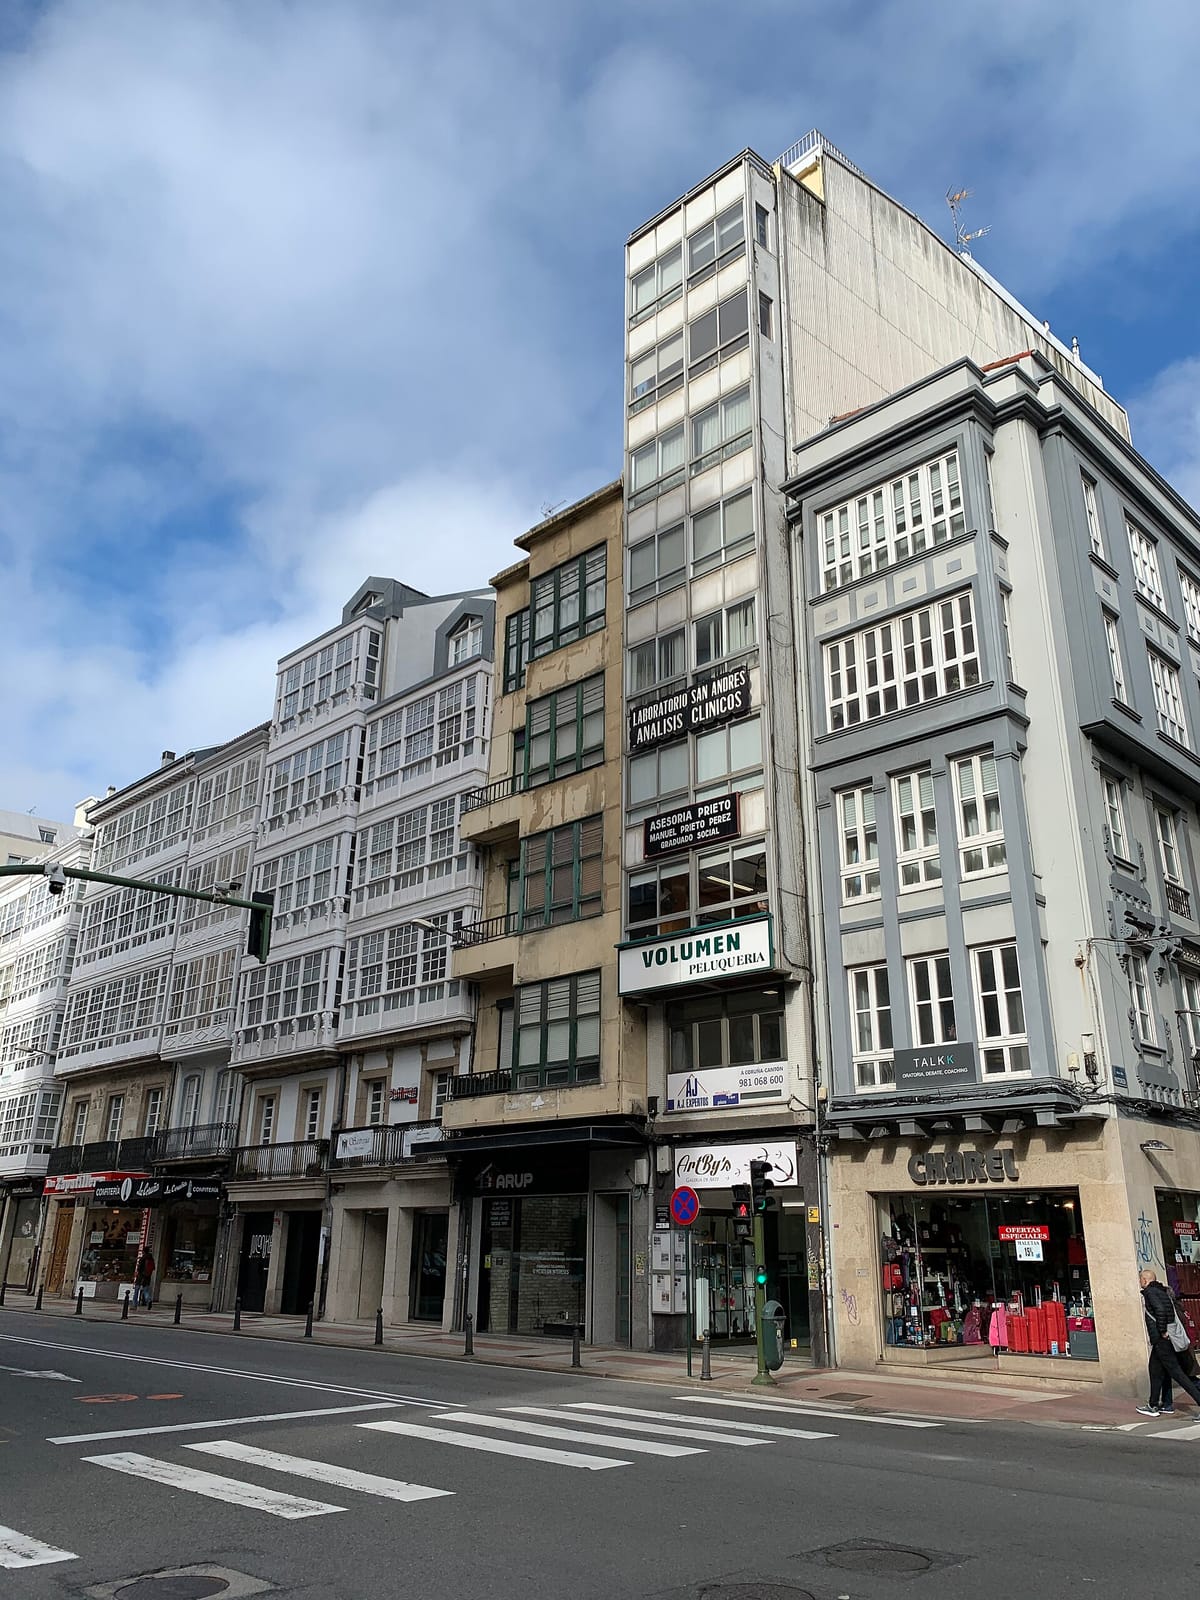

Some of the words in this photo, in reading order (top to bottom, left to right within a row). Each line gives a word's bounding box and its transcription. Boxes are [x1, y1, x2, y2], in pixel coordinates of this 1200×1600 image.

[632, 693, 688, 727] LABORATORIO
[690, 684, 708, 704] SAN
[711, 670, 746, 697] ANDRES
[636, 713, 683, 744] ANALISIS
[691, 691, 742, 724] CLINICOS
[649, 811, 692, 832] ASESORIA
[697, 799, 731, 818] PRIETO
[649, 828, 677, 843] MANUEL
[680, 820, 705, 834] PRIETO
[708, 812, 731, 826] PEREZ
[660, 834, 693, 849] GRADUADO
[697, 827, 720, 840] SOCIAL
[642, 932, 741, 968] VOLUMEN
[689, 952, 765, 975] PELUQUERIA
[912, 1055, 955, 1068] TALKK
[943, 1067, 969, 1075] COACHING
[685, 1077, 698, 1098] AJ
[739, 1078, 752, 1088] 981
[754, 1076, 768, 1087] 068
[770, 1075, 784, 1085] 600
[686, 1097, 709, 1108] EXPERTOS
[677, 1153, 732, 1178] ArtBy's
[495, 1172, 534, 1189] ARUP
